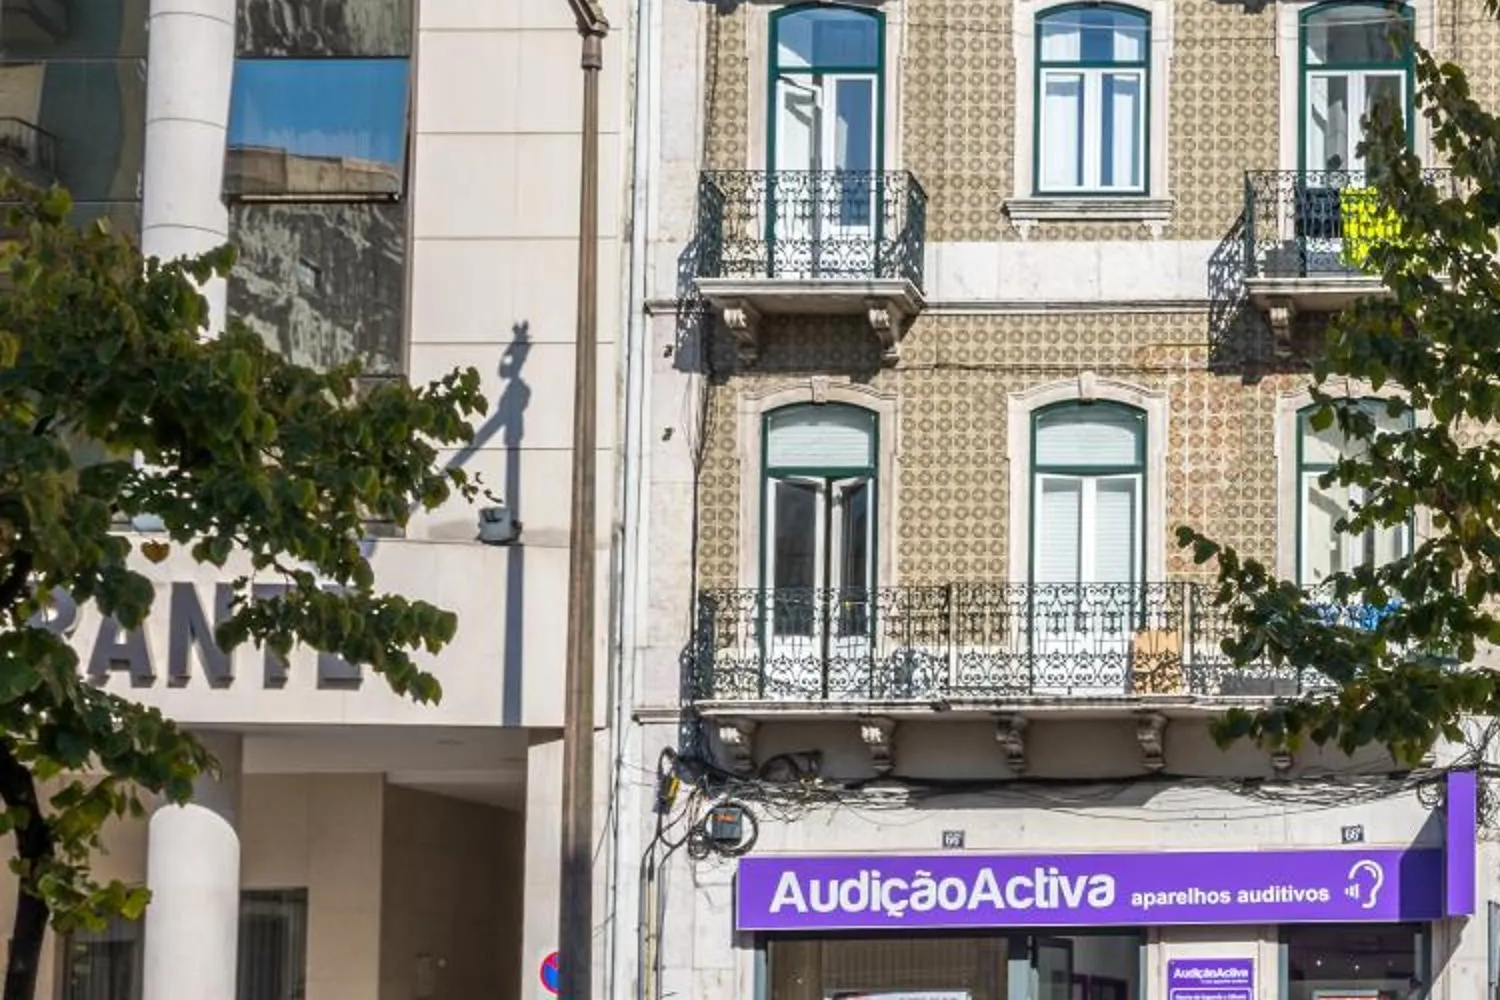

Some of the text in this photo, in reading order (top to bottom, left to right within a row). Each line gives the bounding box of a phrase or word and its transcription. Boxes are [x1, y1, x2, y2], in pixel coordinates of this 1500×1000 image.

[768, 867, 1331, 917] AudiçãoActiva aparelhos auditivos
